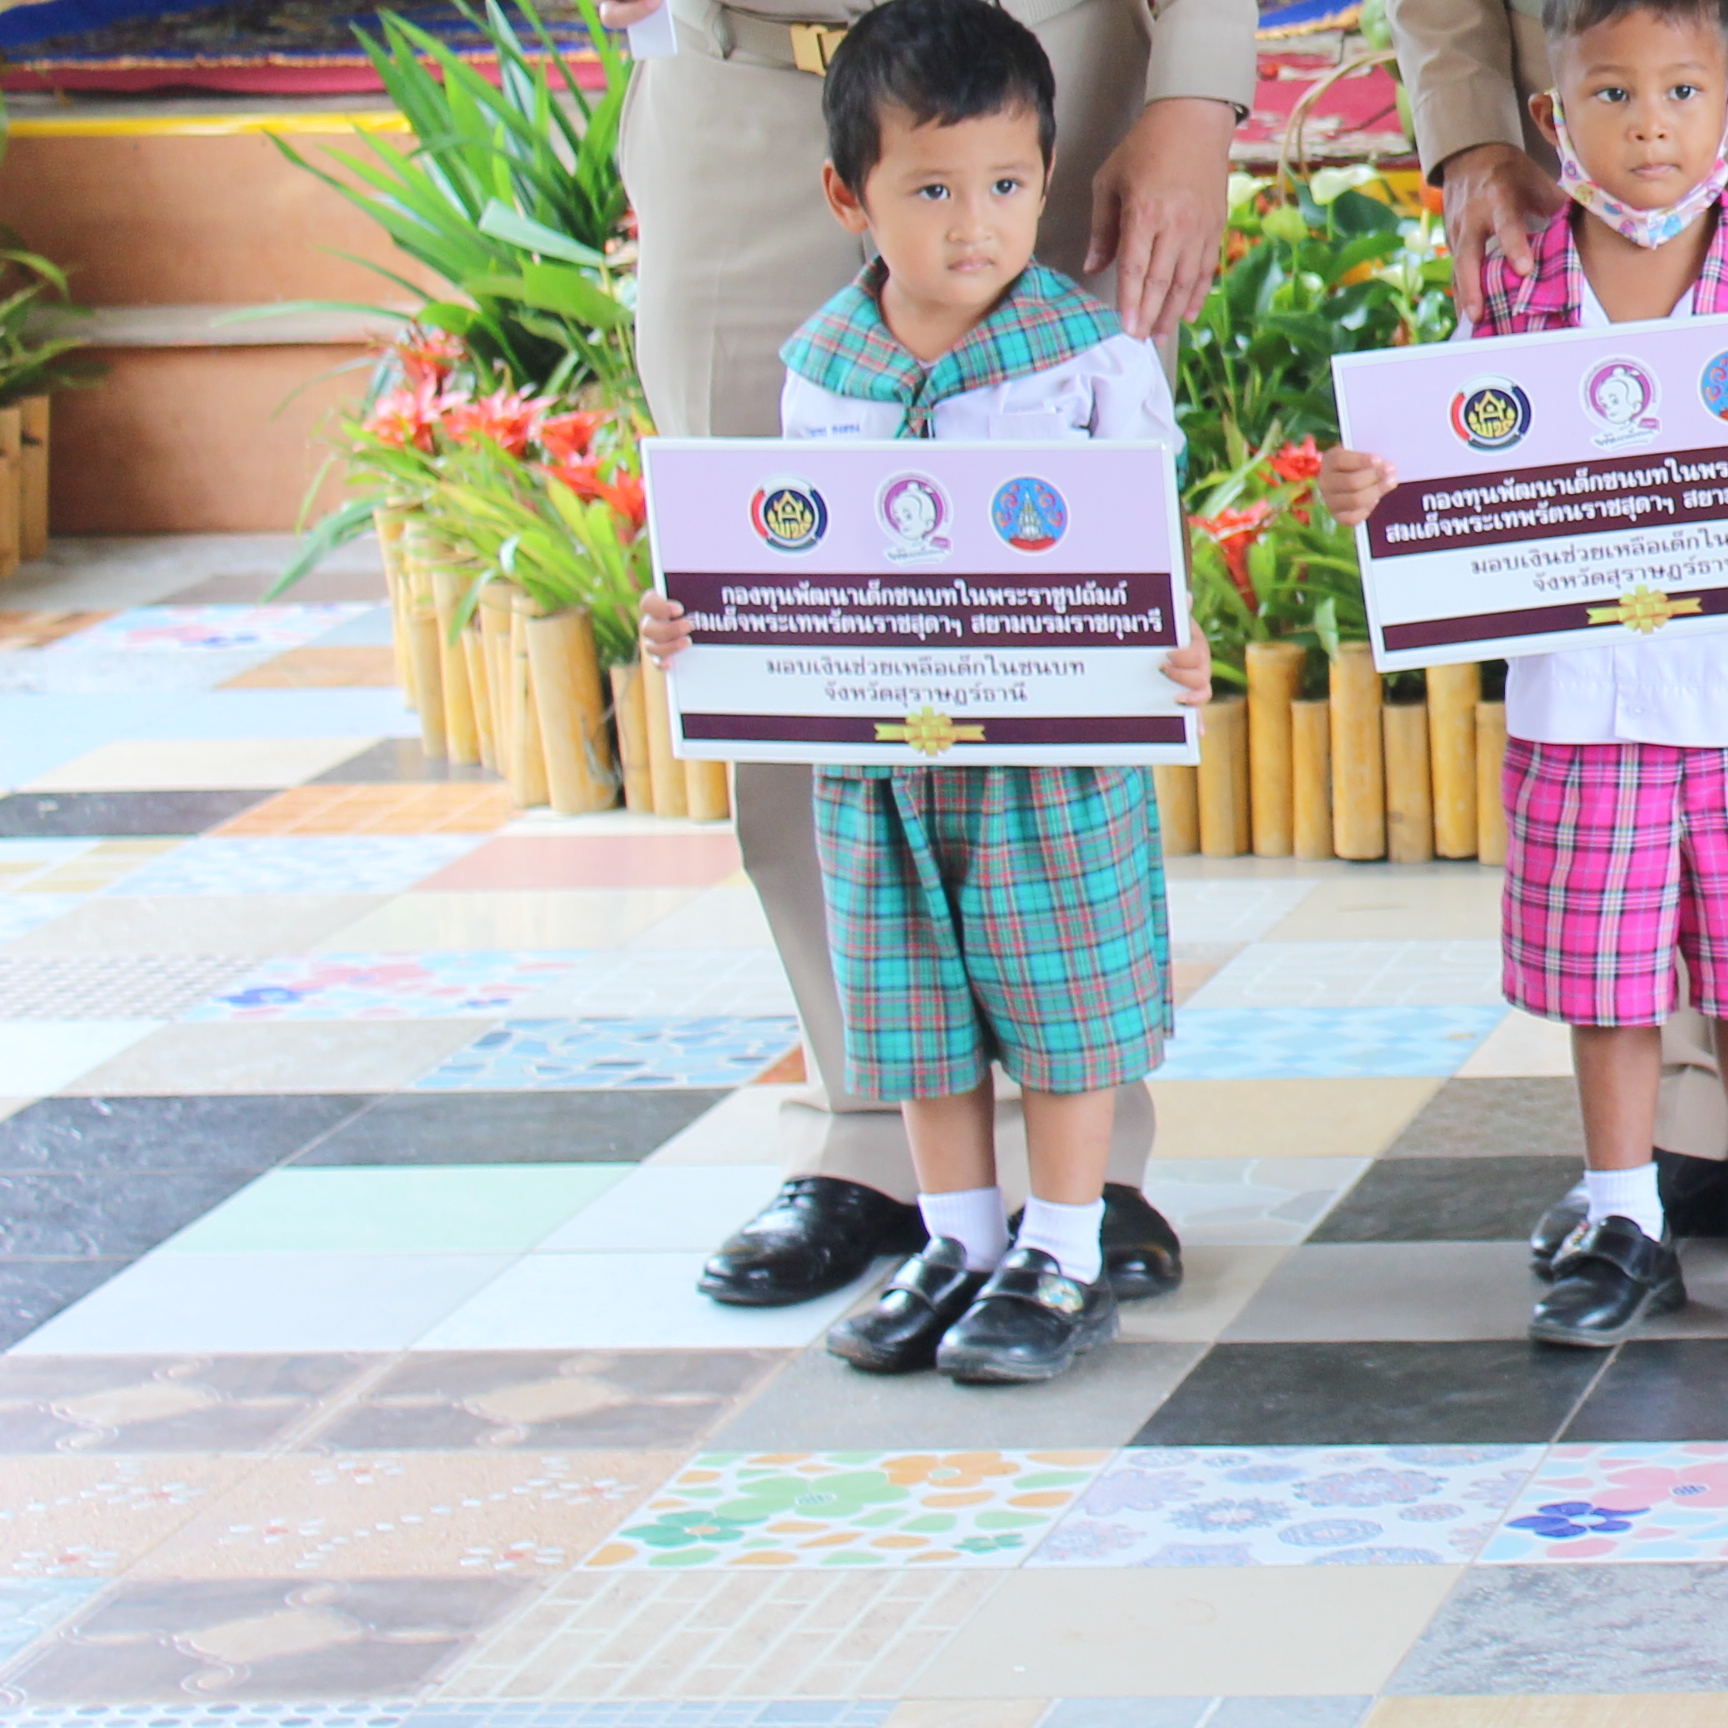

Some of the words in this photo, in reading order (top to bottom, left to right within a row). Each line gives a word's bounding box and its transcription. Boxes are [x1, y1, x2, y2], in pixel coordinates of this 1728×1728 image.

[721, 577, 1128, 613] กองทุนพัฒนาเด็กชนบทในพระราชูปถัมภ์
[970, 609, 1163, 642] สยามบรมราชกุมารี
[766, 655, 1086, 677] มอบเงินช่วยเหลือเด็กในชนบท
[824, 681, 1028, 708] จังหวัดสุราษฎร์ธานี
